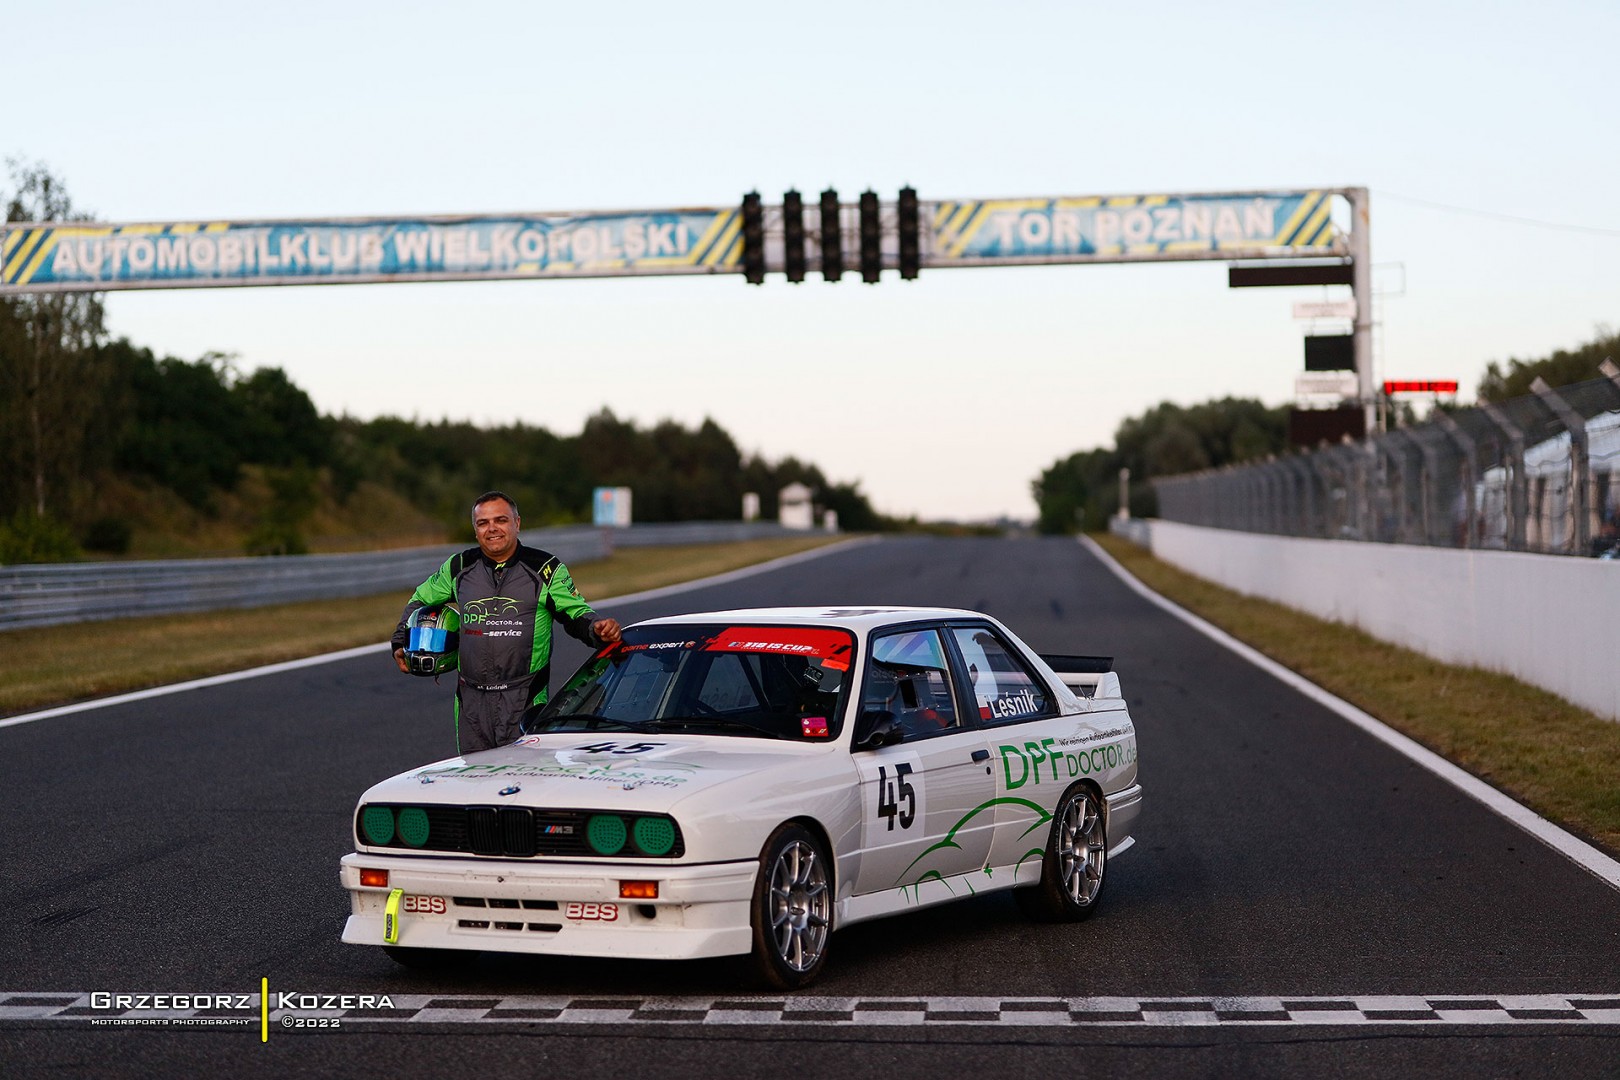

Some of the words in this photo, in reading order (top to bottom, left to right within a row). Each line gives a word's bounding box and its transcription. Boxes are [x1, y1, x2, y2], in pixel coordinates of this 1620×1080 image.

[989, 211, 1083, 248] TOR
[1095, 198, 1276, 245] POZNAŃ
[51, 230, 384, 275] AUTOMOBILKLUB
[395, 222, 689, 264] WIELKOPOLSKI
[648, 641, 685, 651] expert
[782, 644, 814, 652] CUP
[986, 688, 1039, 719] Leśnik
[573, 741, 668, 754] 45
[877, 762, 916, 832] 45
[552, 825, 574, 835] M3
[403, 895, 446, 915] BBS
[566, 901, 618, 922] BBS
